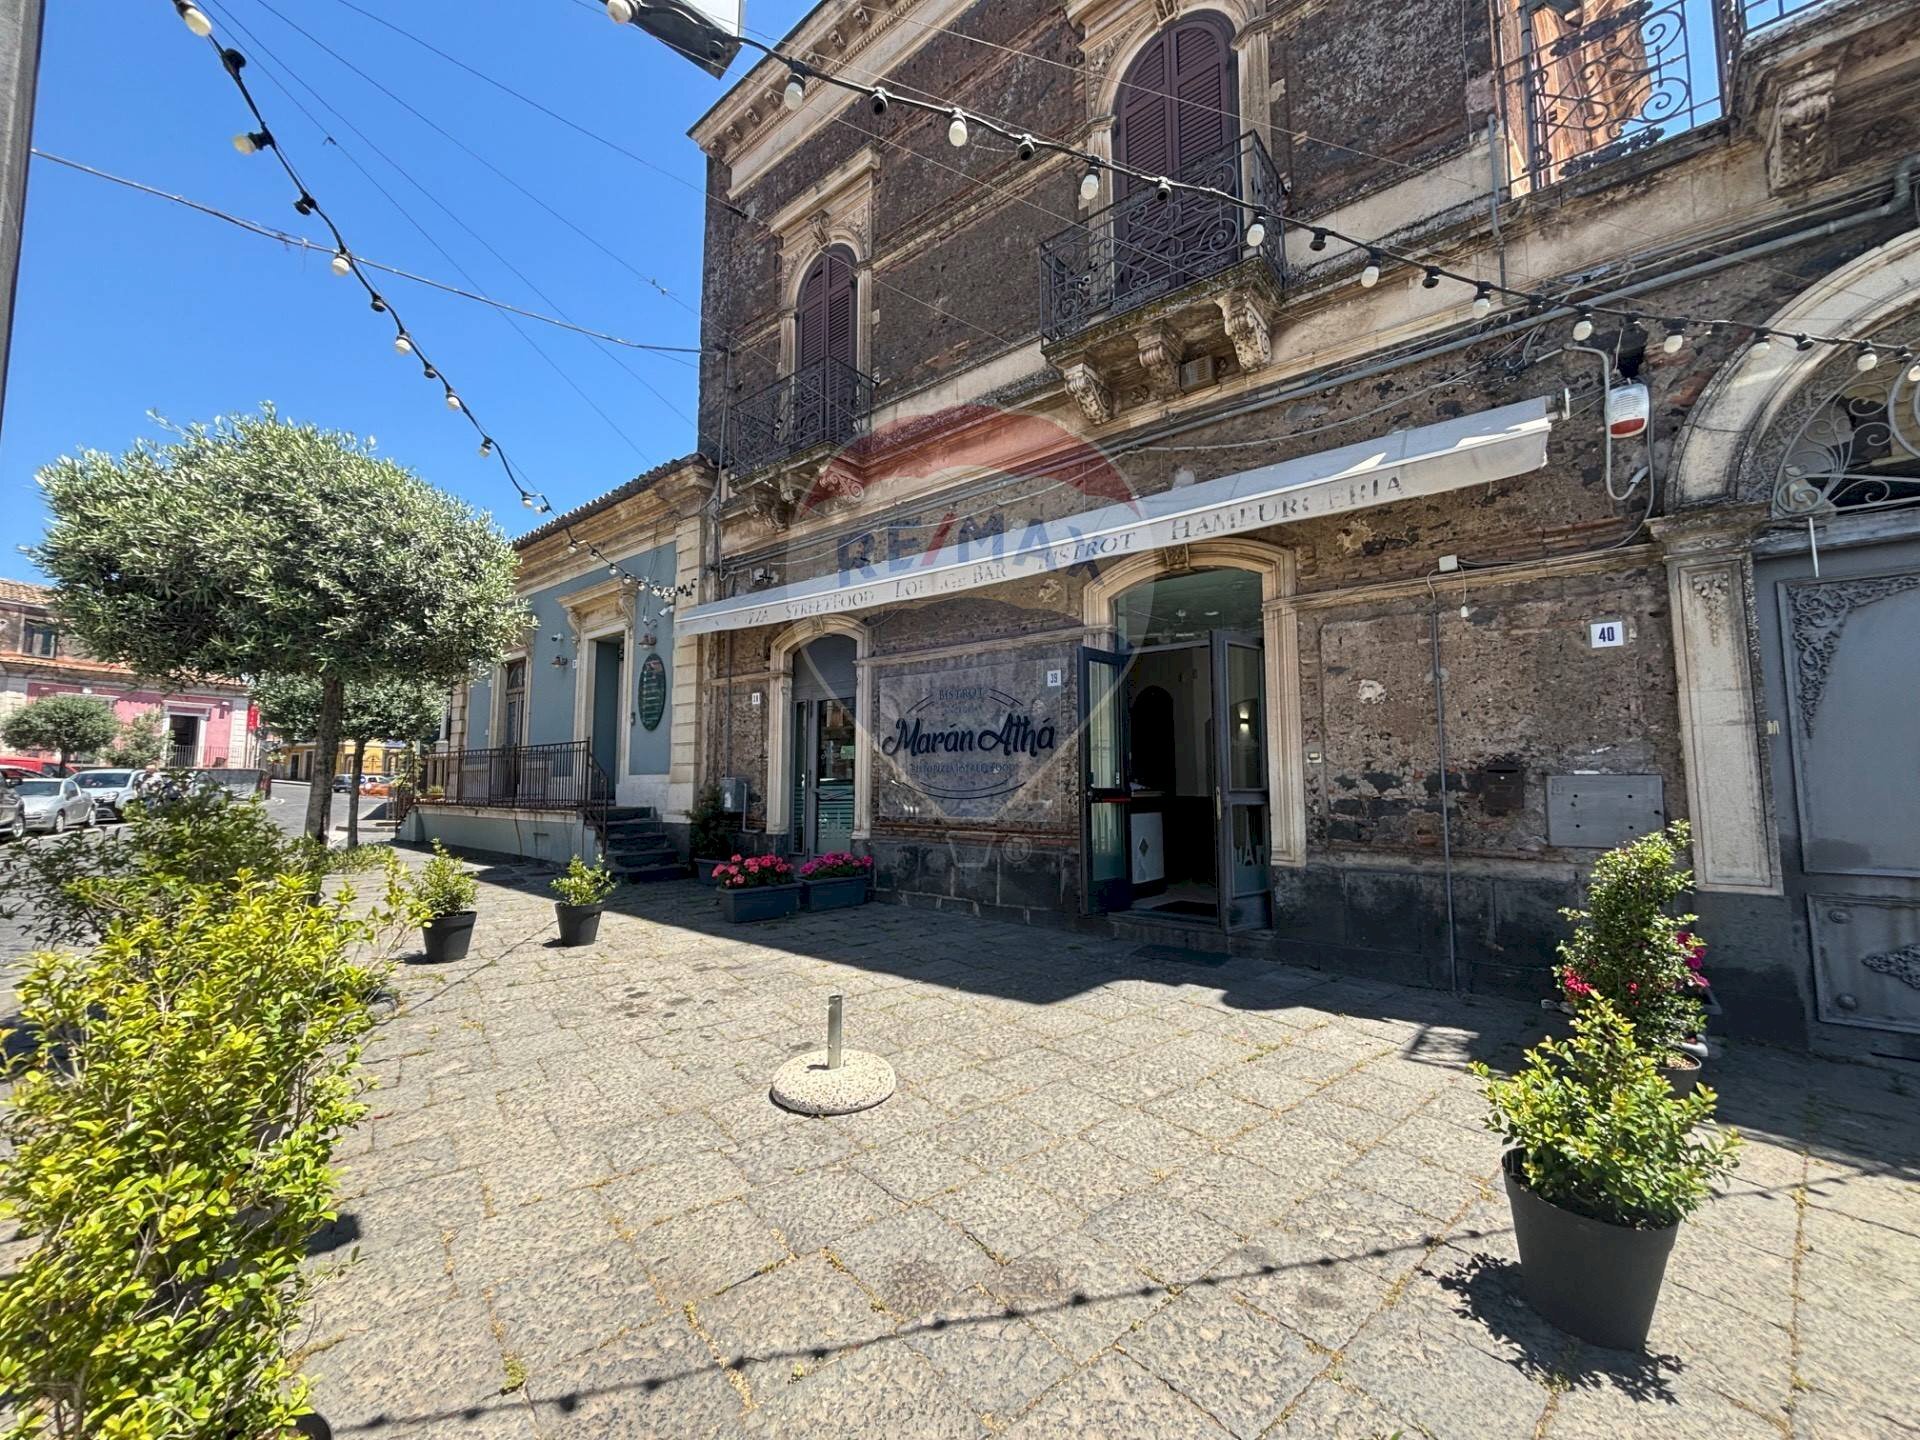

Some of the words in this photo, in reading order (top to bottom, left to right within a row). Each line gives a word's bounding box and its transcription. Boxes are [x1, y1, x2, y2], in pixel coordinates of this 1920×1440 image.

[895, 572, 967, 598] LOUGE
[972, 560, 1008, 584] BAR
[1599, 626, 1615, 642] 40
[1050, 672, 1058, 684] 39
[881, 718, 974, 757] Marán
[977, 711, 1055, 757] Athá
